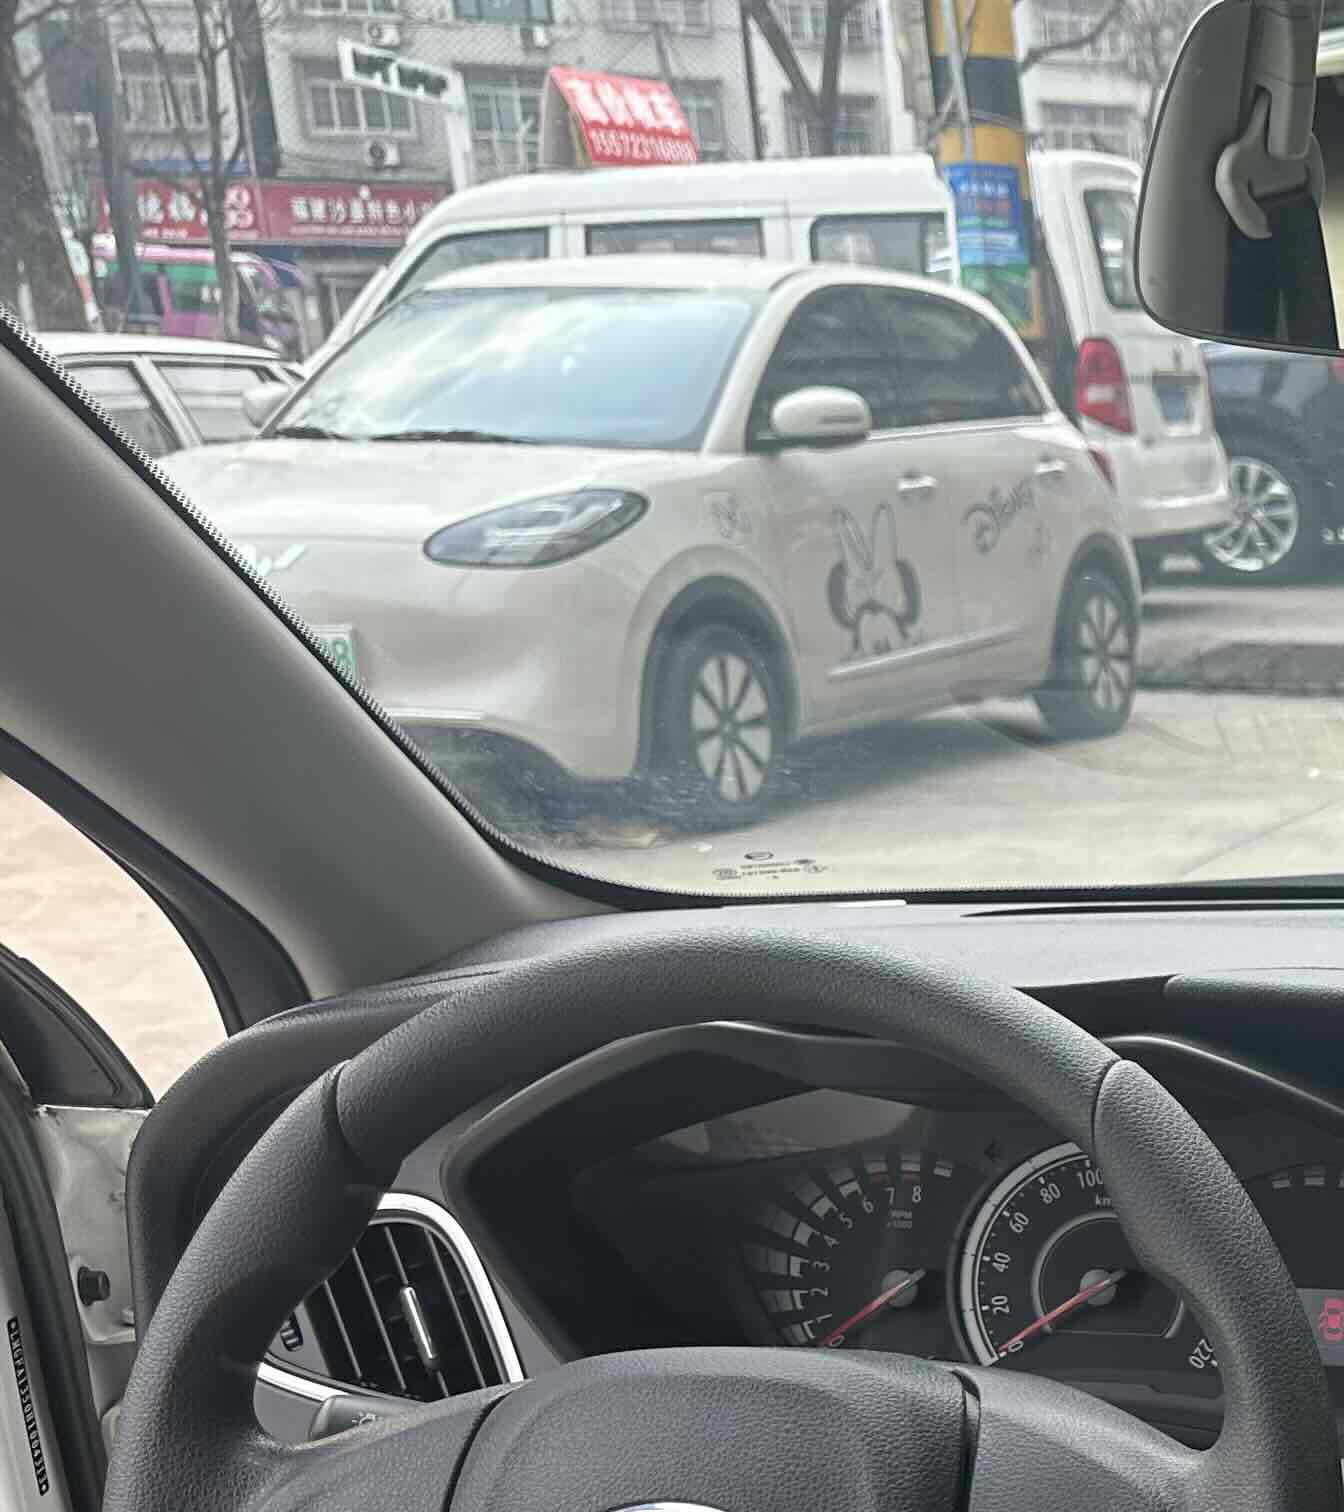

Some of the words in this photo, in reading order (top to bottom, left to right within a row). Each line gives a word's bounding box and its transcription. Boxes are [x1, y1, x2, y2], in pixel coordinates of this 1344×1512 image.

[884, 1186, 896, 1205] 7
[911, 1185, 922, 1203] 8
[1039, 1183, 1062, 1205] 80
[861, 1197, 874, 1214] 6
[838, 1211, 854, 1229] 5
[1009, 1212, 1030, 1234] 60
[823, 1234, 840, 1249] 4
[813, 1260, 831, 1273] 3
[992, 1251, 1012, 1273] 40
[810, 1287, 829, 1297] 2
[991, 1295, 1010, 1315] 20
[815, 1313, 833, 1324] 1
[1007, 1339, 1025, 1353] 0
[1188, 1338, 1214, 1369] 220
